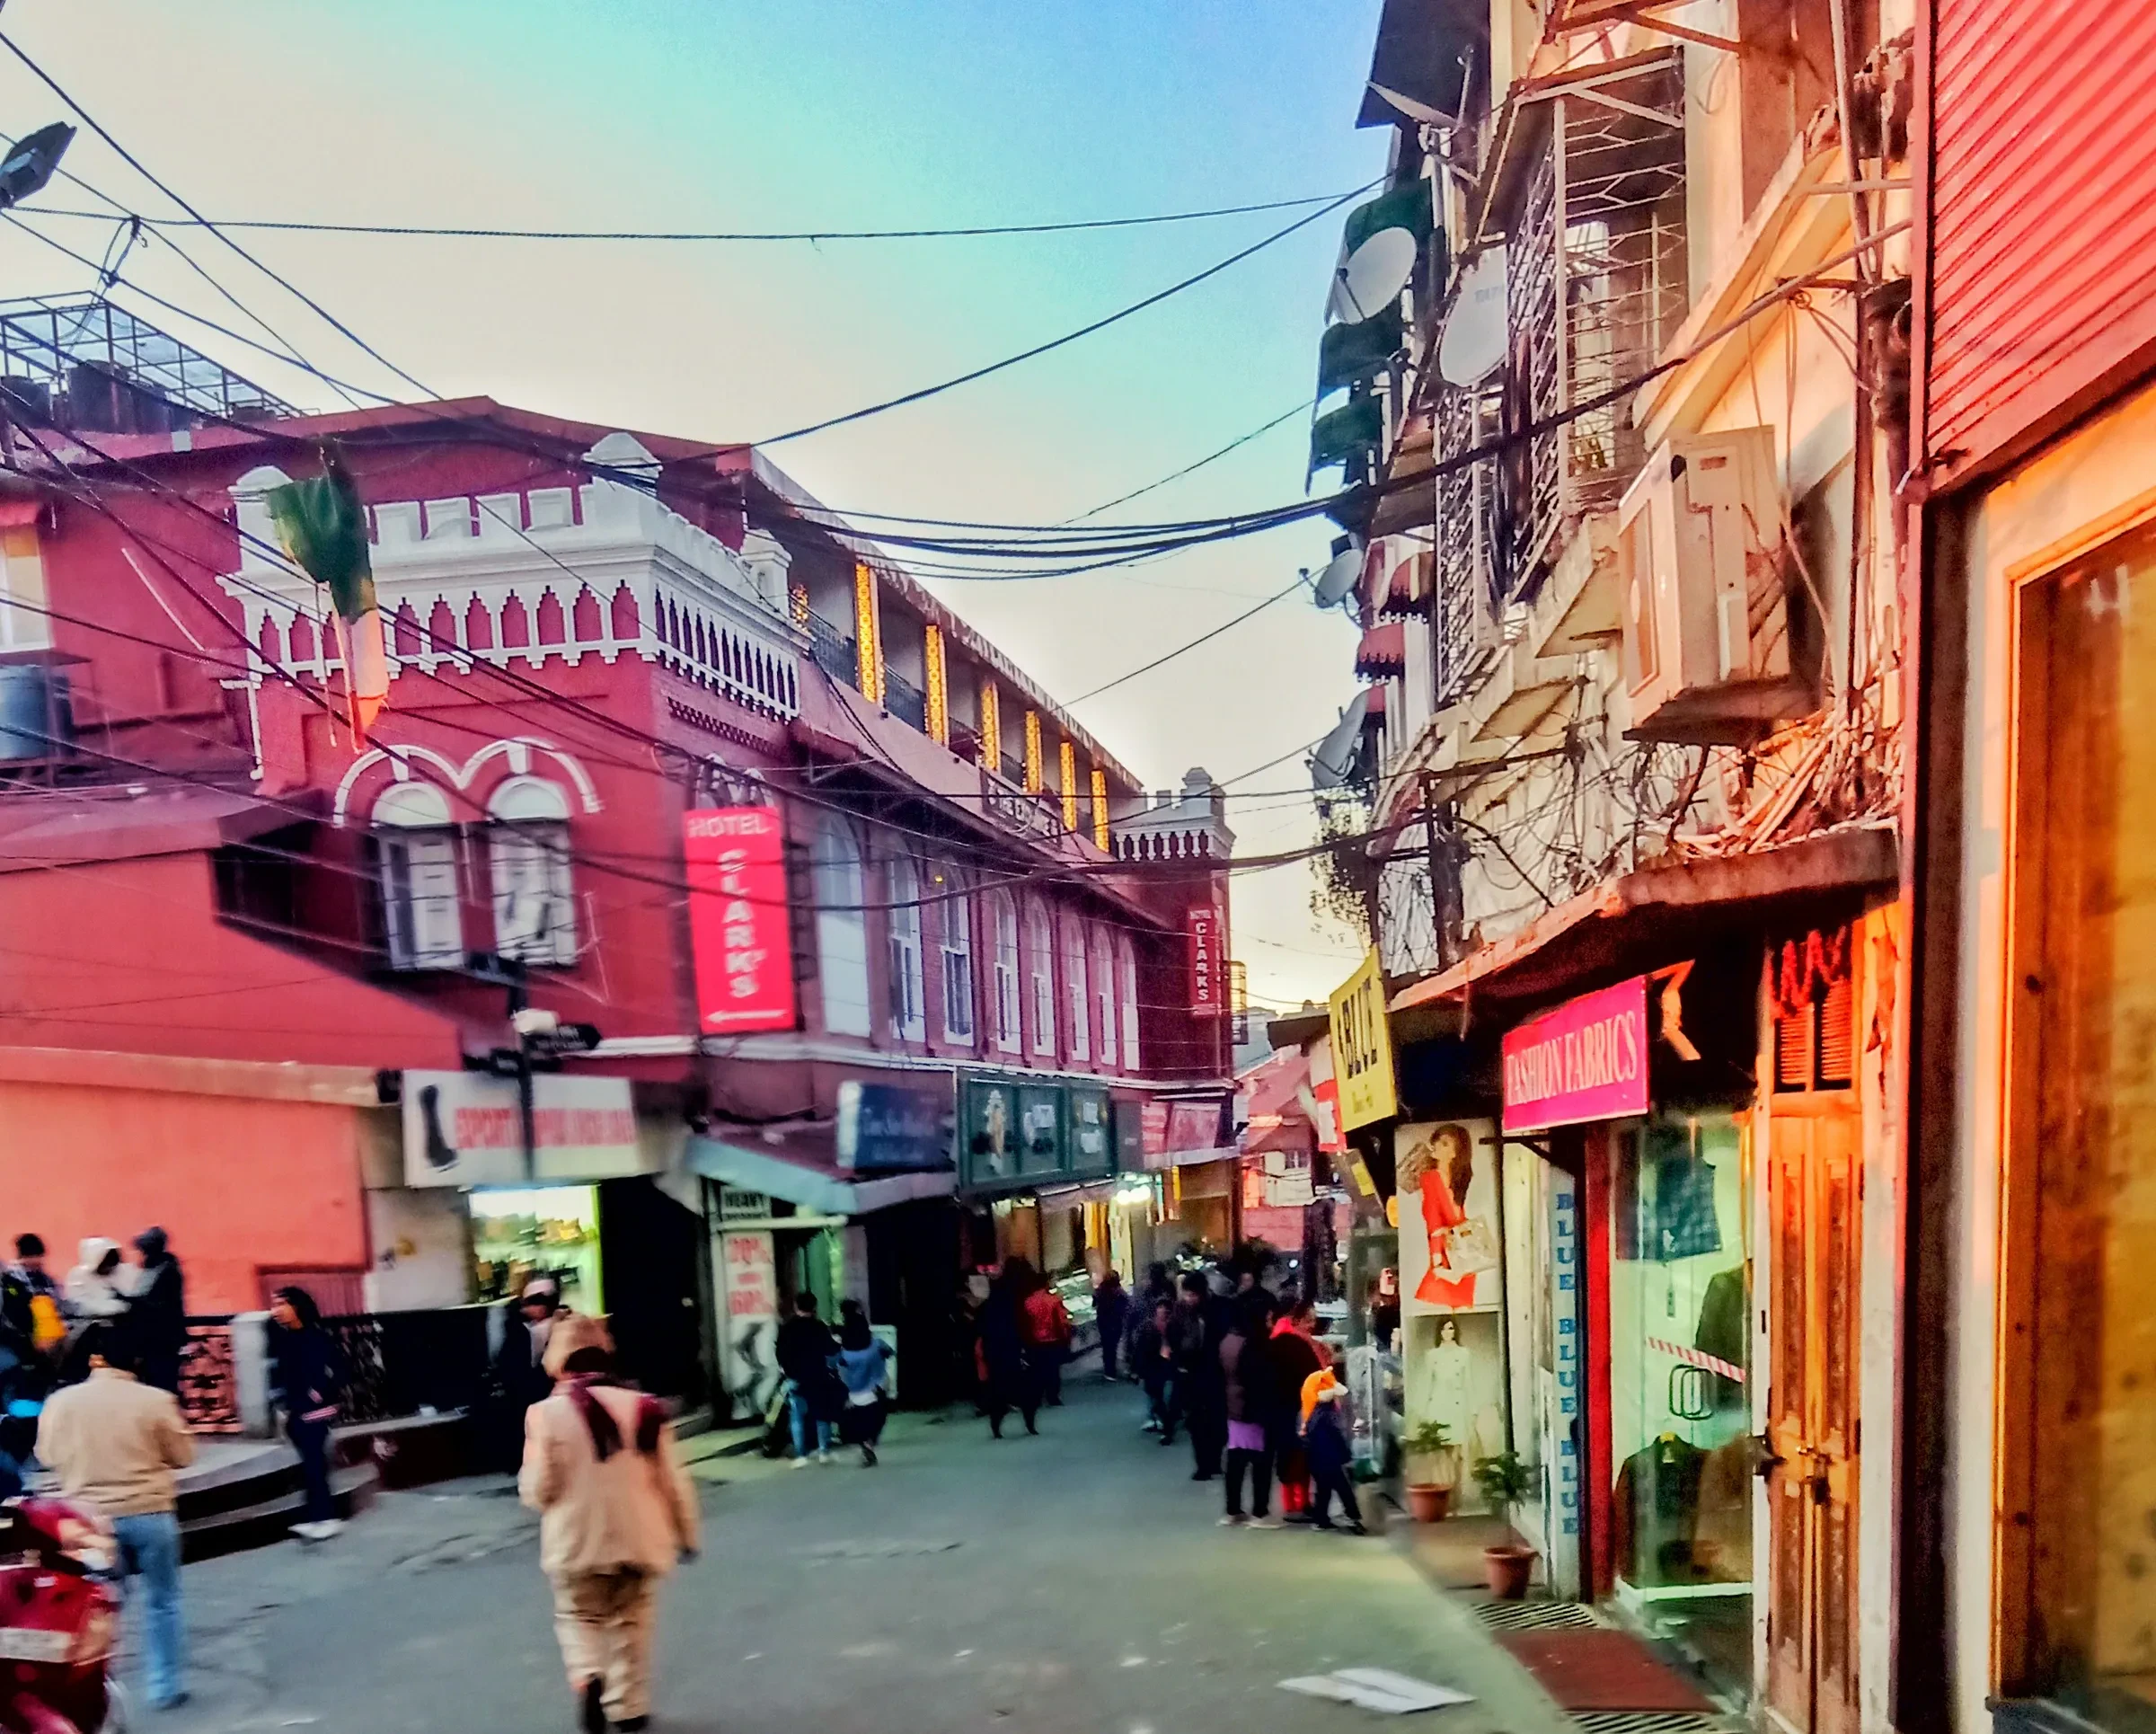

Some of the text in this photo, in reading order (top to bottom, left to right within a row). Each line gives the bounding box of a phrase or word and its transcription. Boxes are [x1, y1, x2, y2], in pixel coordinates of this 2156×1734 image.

[687, 813, 773, 838] HOTEL
[1195, 922, 1210, 1001] CLARKS
[1507, 1011, 1637, 1106] FASHION FABRICS
[1556, 1194, 1575, 1290] BLUE
[1559, 1318, 1577, 1413] BLUE
